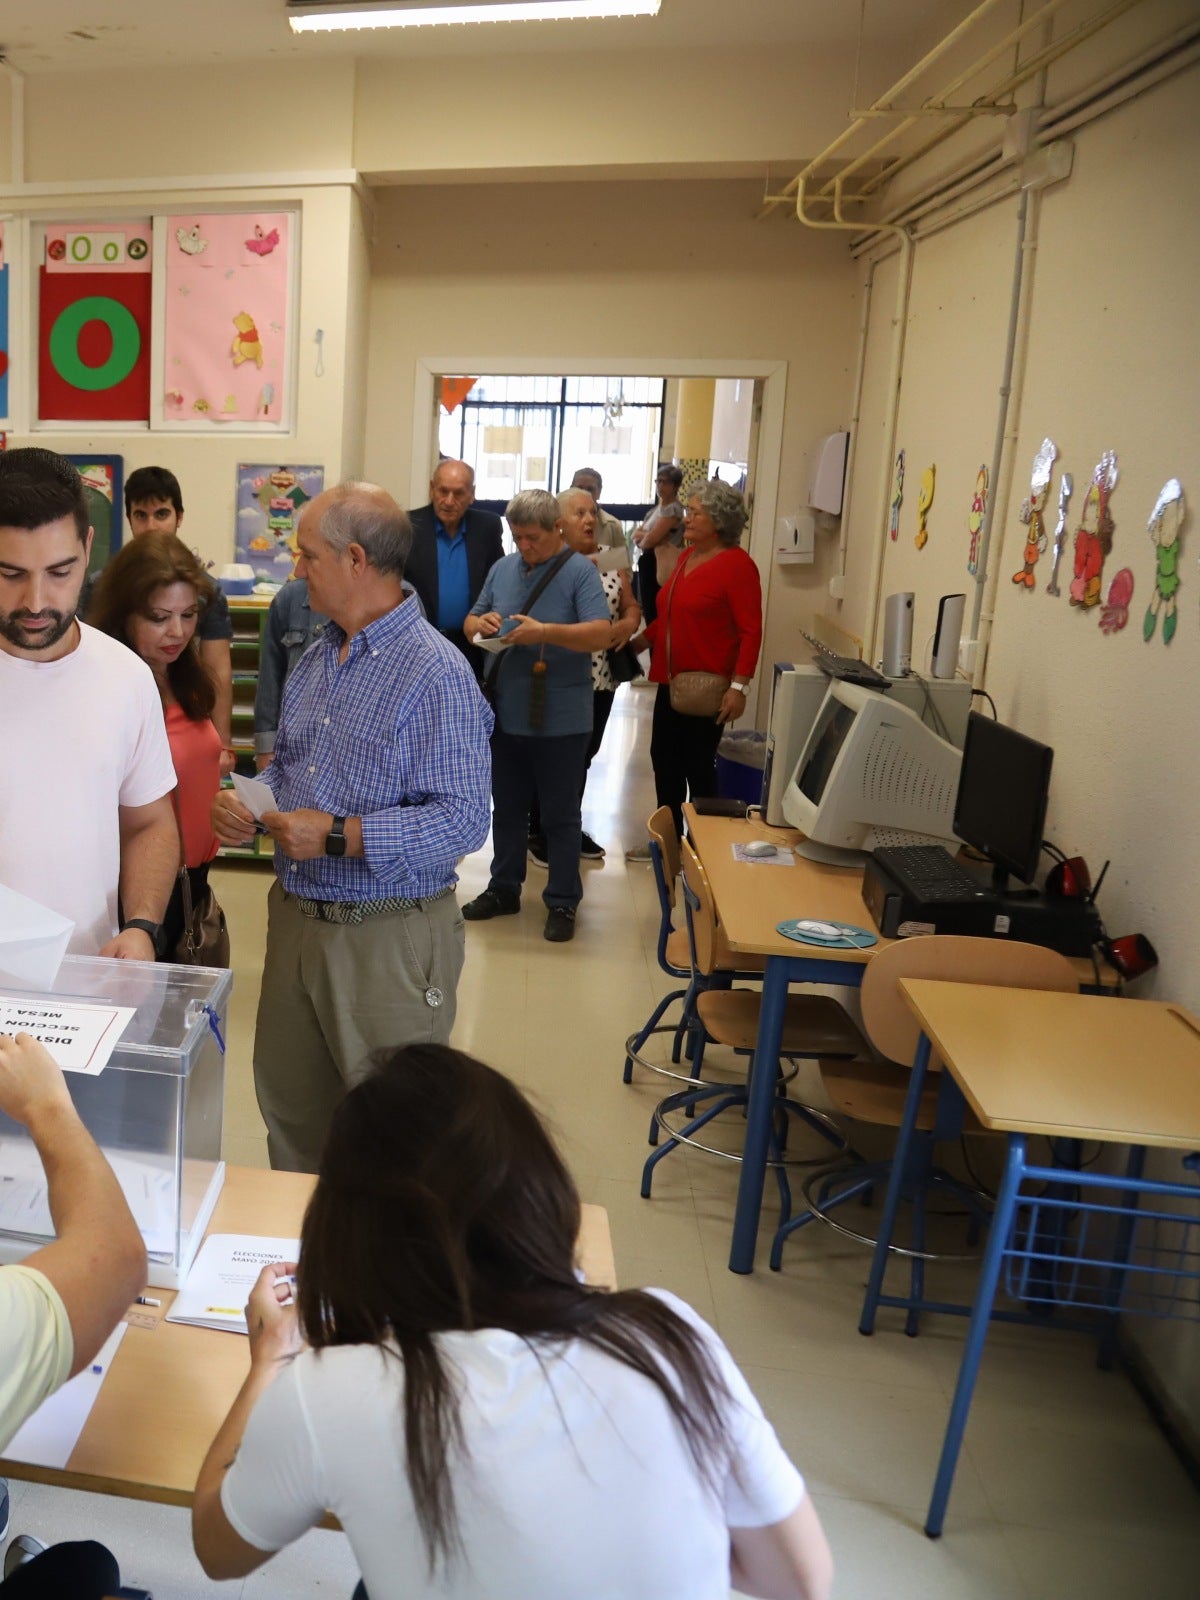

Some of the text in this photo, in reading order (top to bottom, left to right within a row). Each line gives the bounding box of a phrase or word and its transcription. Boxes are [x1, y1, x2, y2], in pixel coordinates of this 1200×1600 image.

[17, 1009, 62, 1019] MESA
[5, 1020, 80, 1032] SECCION
[231, 1256, 258, 1264] MAYO
[233, 1251, 283, 1260] ELECCIONES
